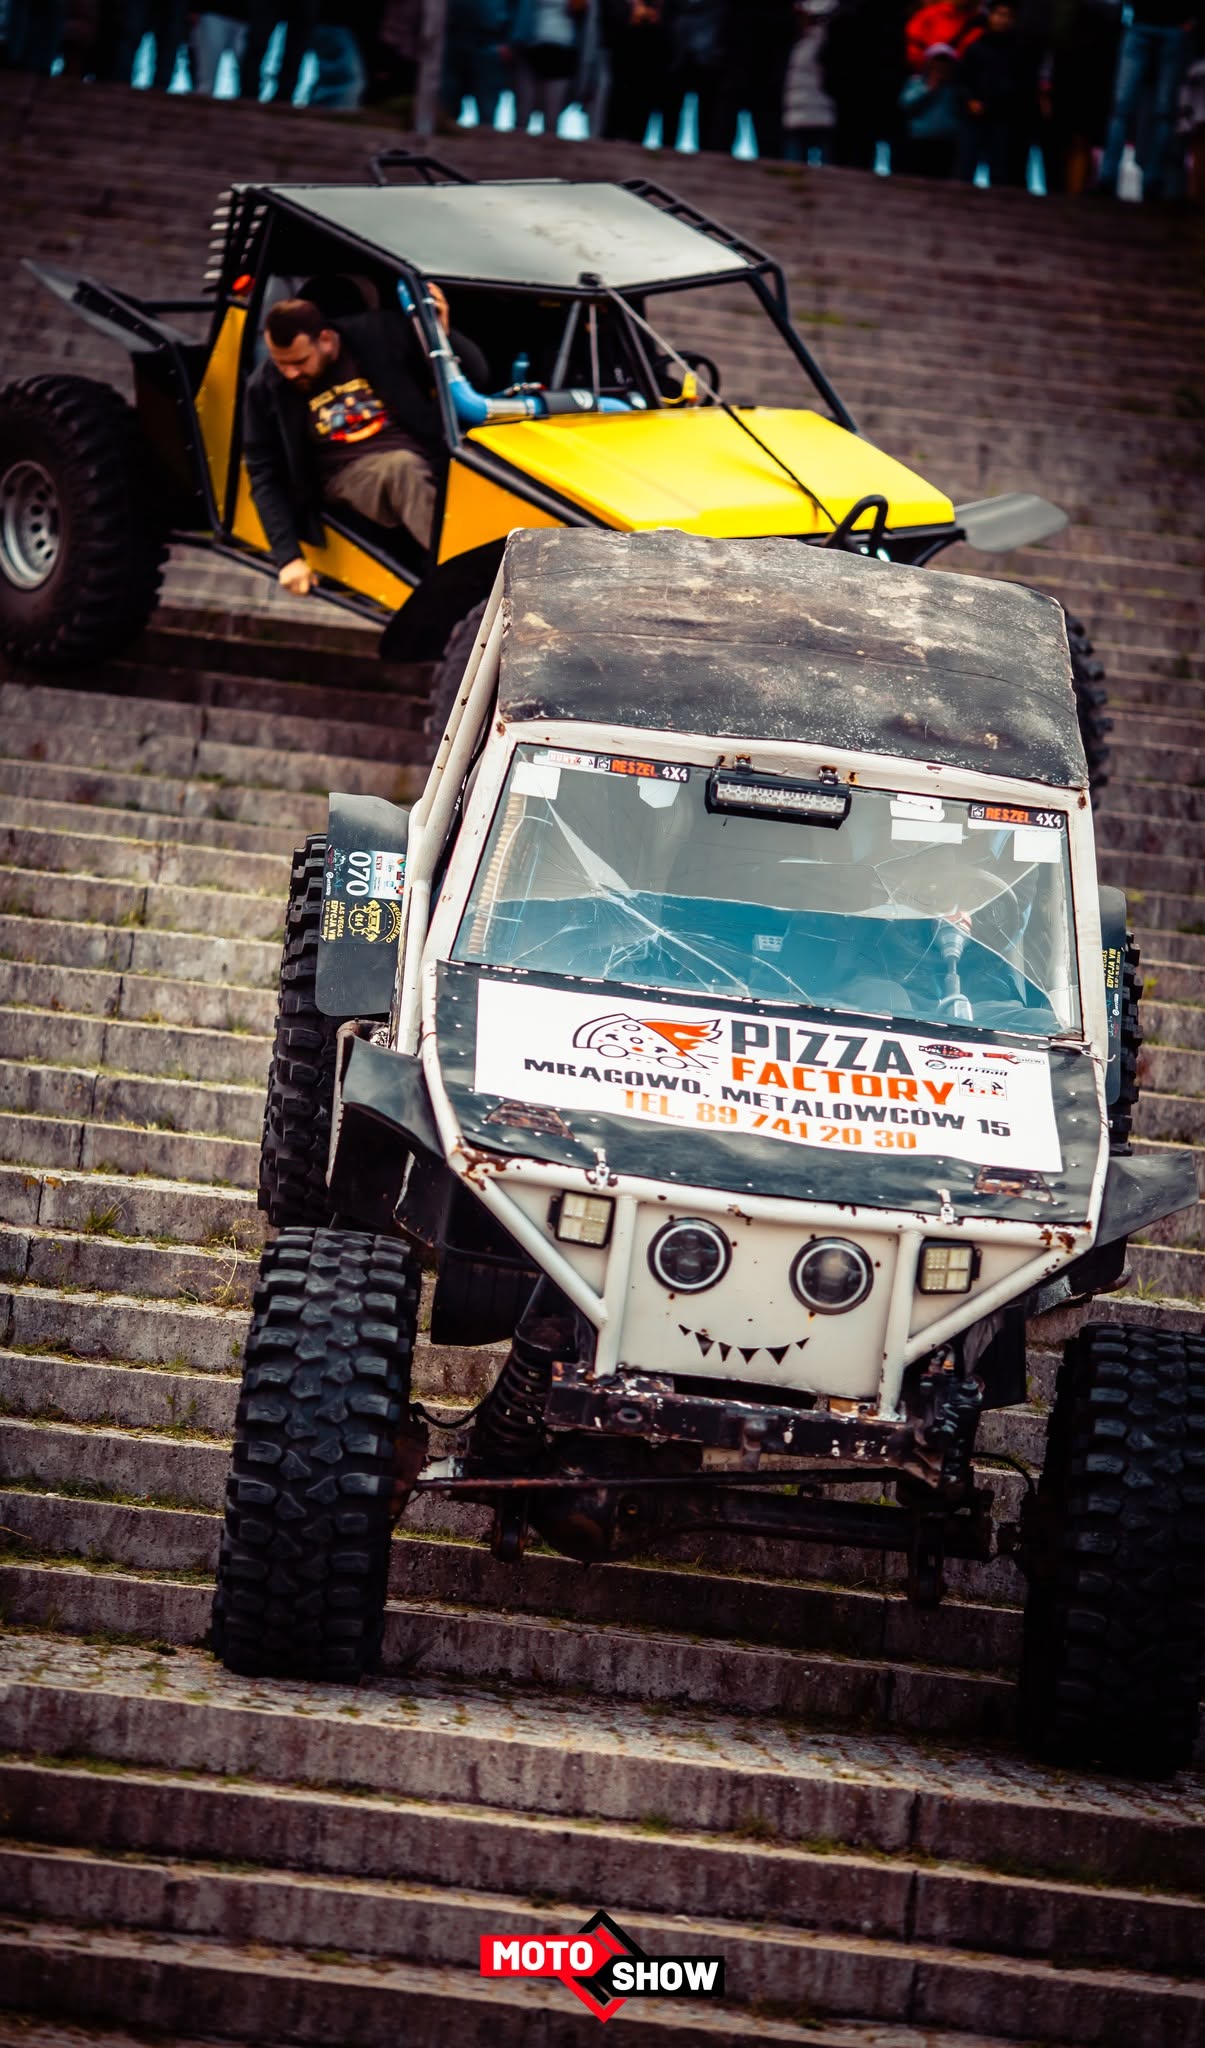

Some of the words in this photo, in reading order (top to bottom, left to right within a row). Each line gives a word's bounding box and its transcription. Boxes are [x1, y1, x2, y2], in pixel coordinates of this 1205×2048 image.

[611, 759, 658, 778] RESZEL
[662, 766, 688, 782] 4X4
[986, 807, 1032, 824] RESZEL
[1036, 813, 1062, 828] 4X4
[346, 851, 372, 896] 070
[330, 900, 338, 927] EDYCJA
[336, 915, 344, 937] VEGAS
[1106, 960, 1114, 988] EDYCJA
[731, 1020, 915, 1076] PIZZA
[524, 1058, 711, 1099] MRĄGOWO,
[721, 1085, 966, 1130] METALOWCÓW
[977, 1118, 1012, 1138] 15
[732, 1057, 955, 1106] FACTORY
[620, 1088, 684, 1121] TEL.
[696, 1102, 739, 1126] 89
[750, 1111, 809, 1139] 741
[820, 1125, 863, 1146] 20
[874, 1130, 917, 1150] 30
